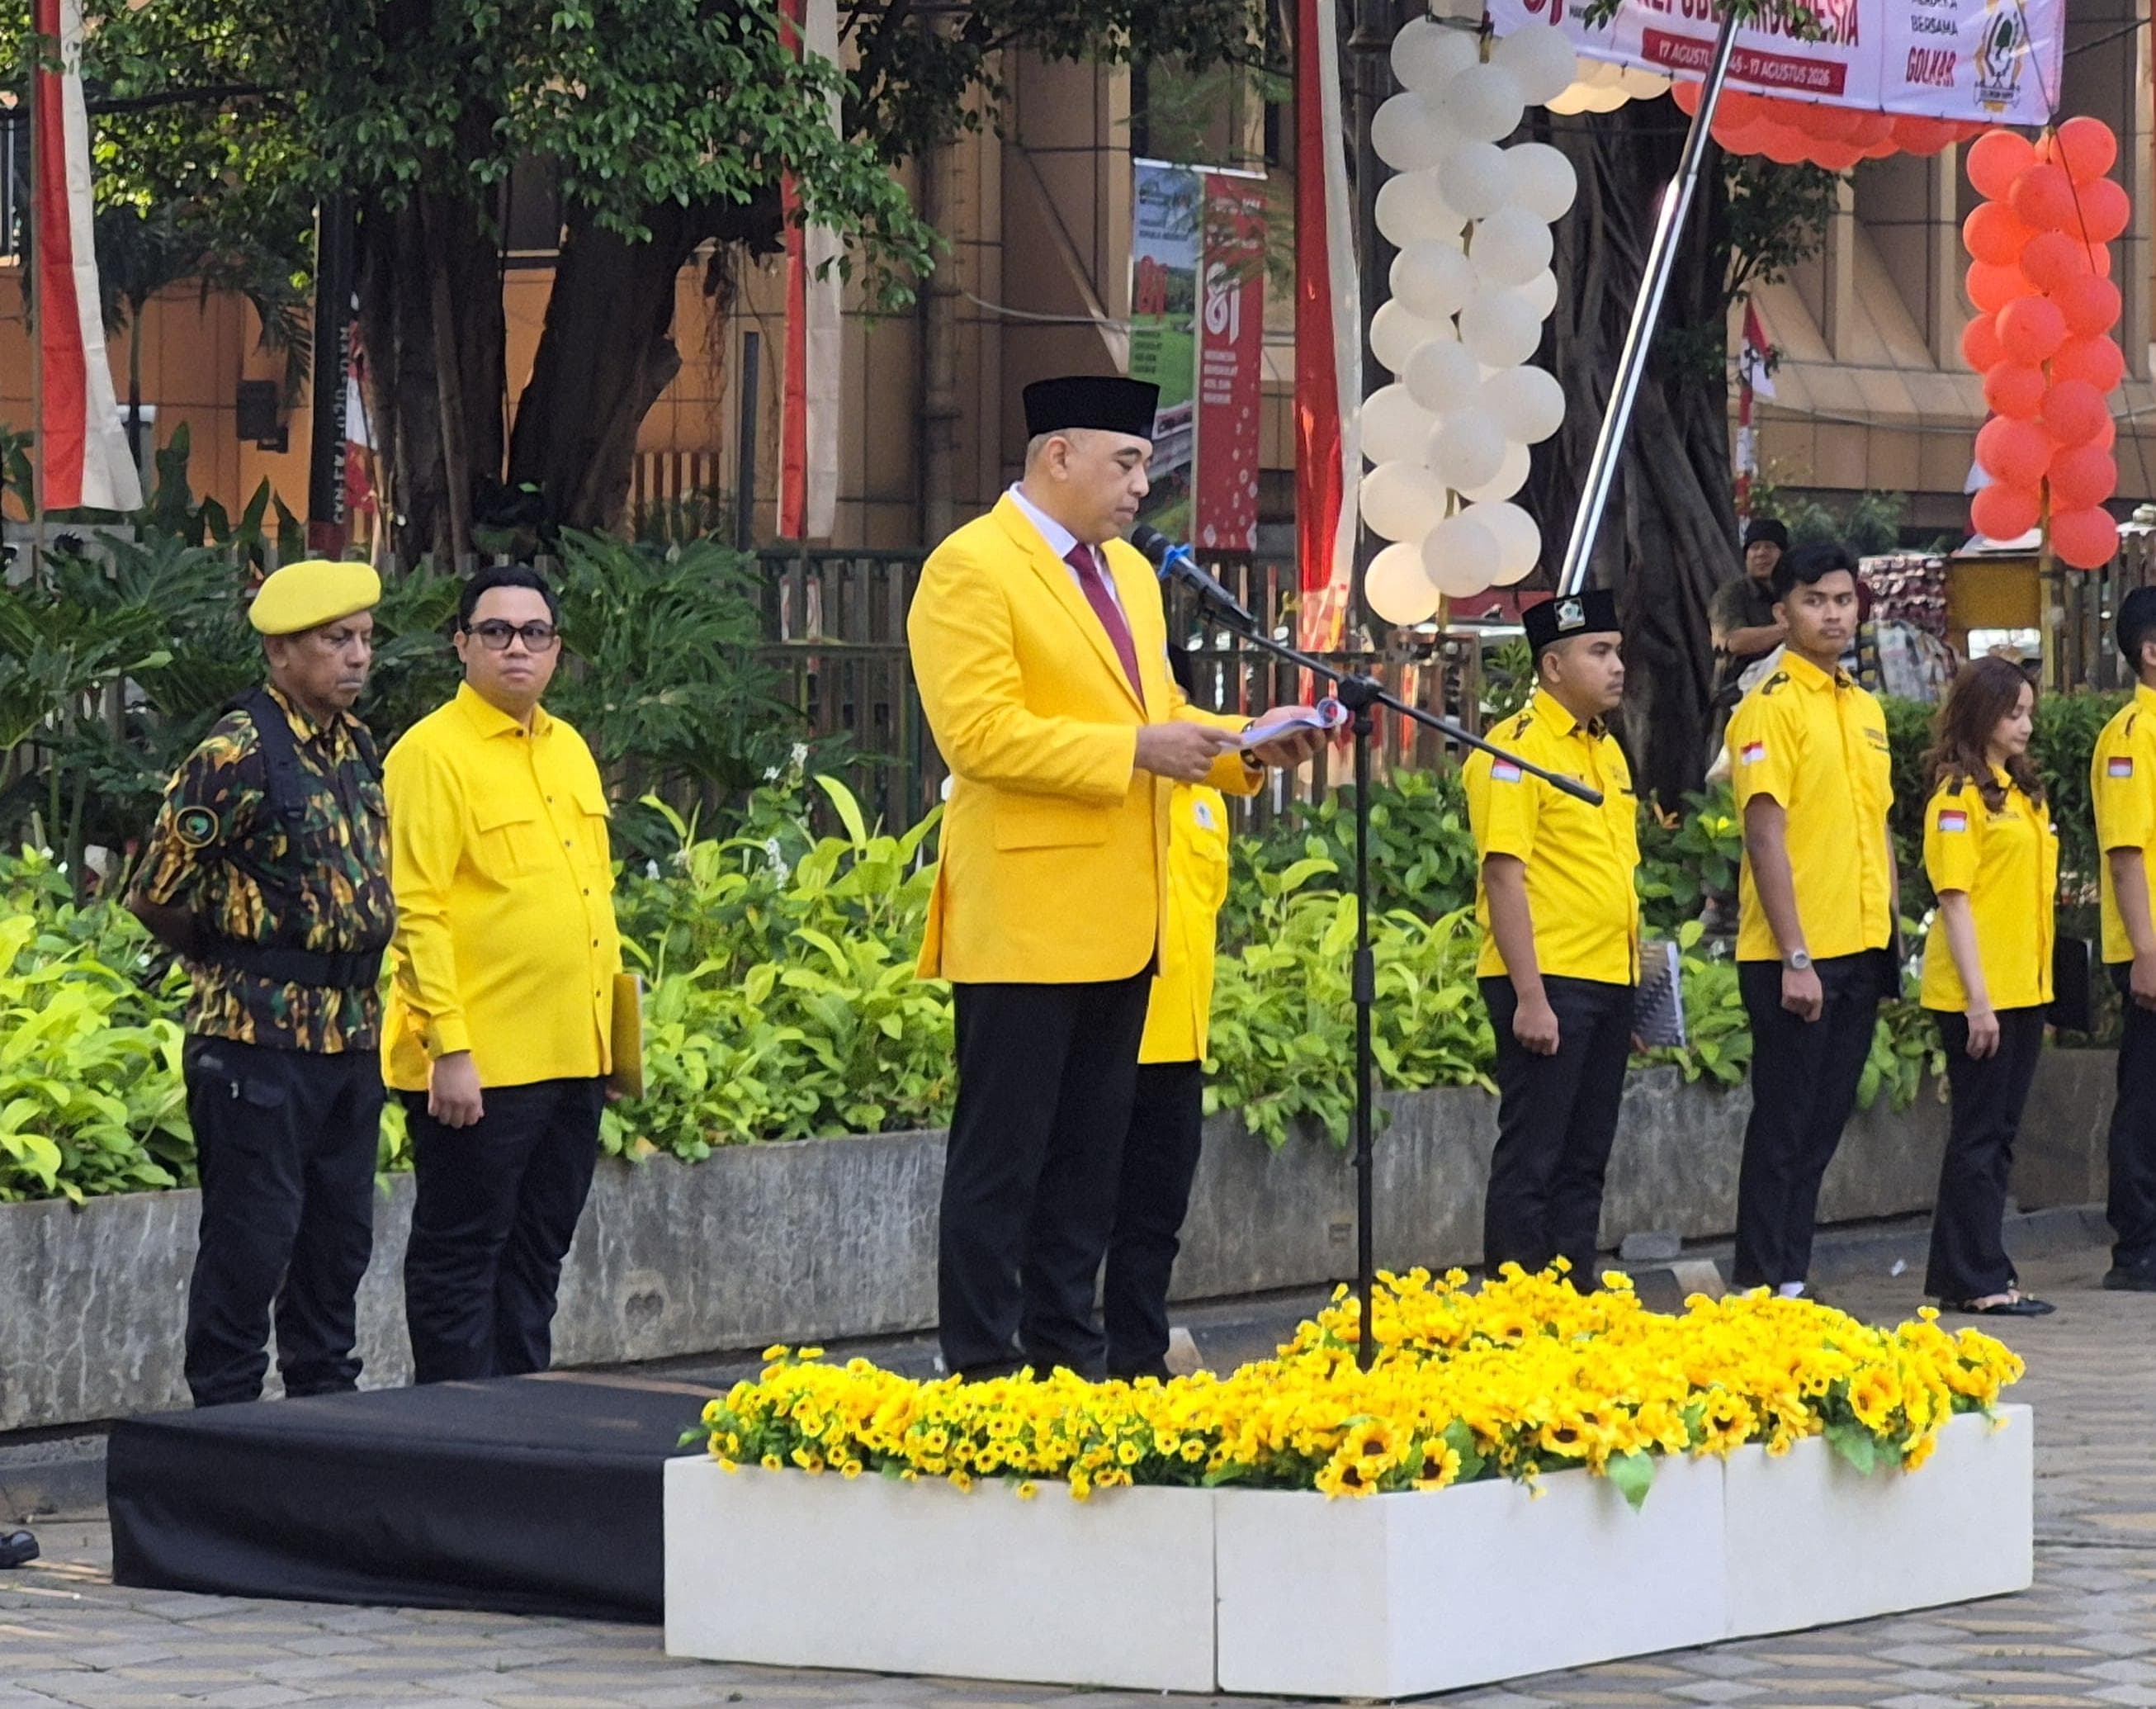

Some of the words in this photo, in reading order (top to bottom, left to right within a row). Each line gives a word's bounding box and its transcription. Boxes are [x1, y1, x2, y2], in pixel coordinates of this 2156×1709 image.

[1911, 15, 1958, 36] BERSAMA
[1659, 40, 1671, 59] 17
[1750, 58, 1760, 75] 17
[1761, 60, 1807, 83] AGUSTUS
[1905, 46, 1956, 88] GOLKAR
